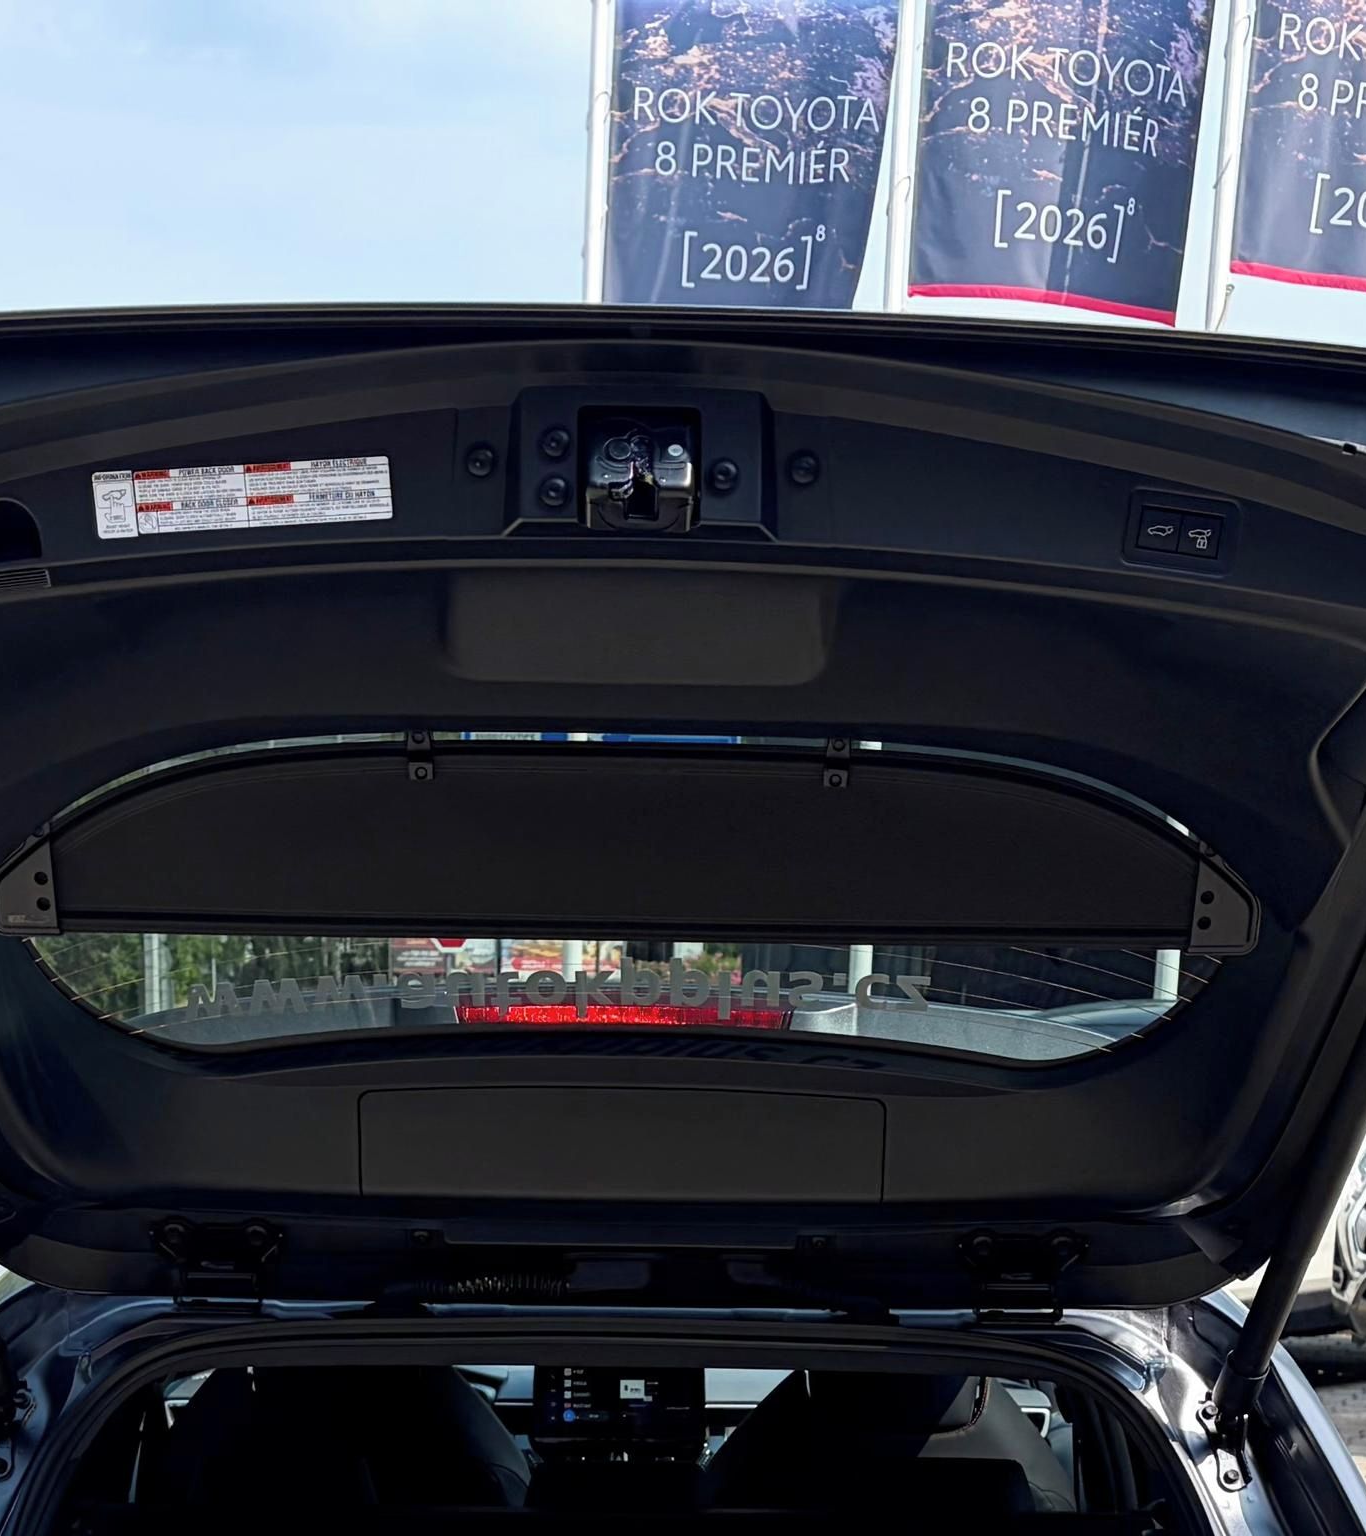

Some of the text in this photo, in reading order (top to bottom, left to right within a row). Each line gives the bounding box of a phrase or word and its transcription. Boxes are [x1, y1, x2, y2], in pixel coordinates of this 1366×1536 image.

[1279, 13, 1364, 61] ROK
[946, 42, 1187, 107] ROK TOYOTA
[1298, 73, 1318, 111] 8
[633, 87, 880, 133] ROK TOYOTA
[968, 97, 1159, 158] 8 PREMIÉR
[655, 140, 850, 185] 8 PREMIÉR
